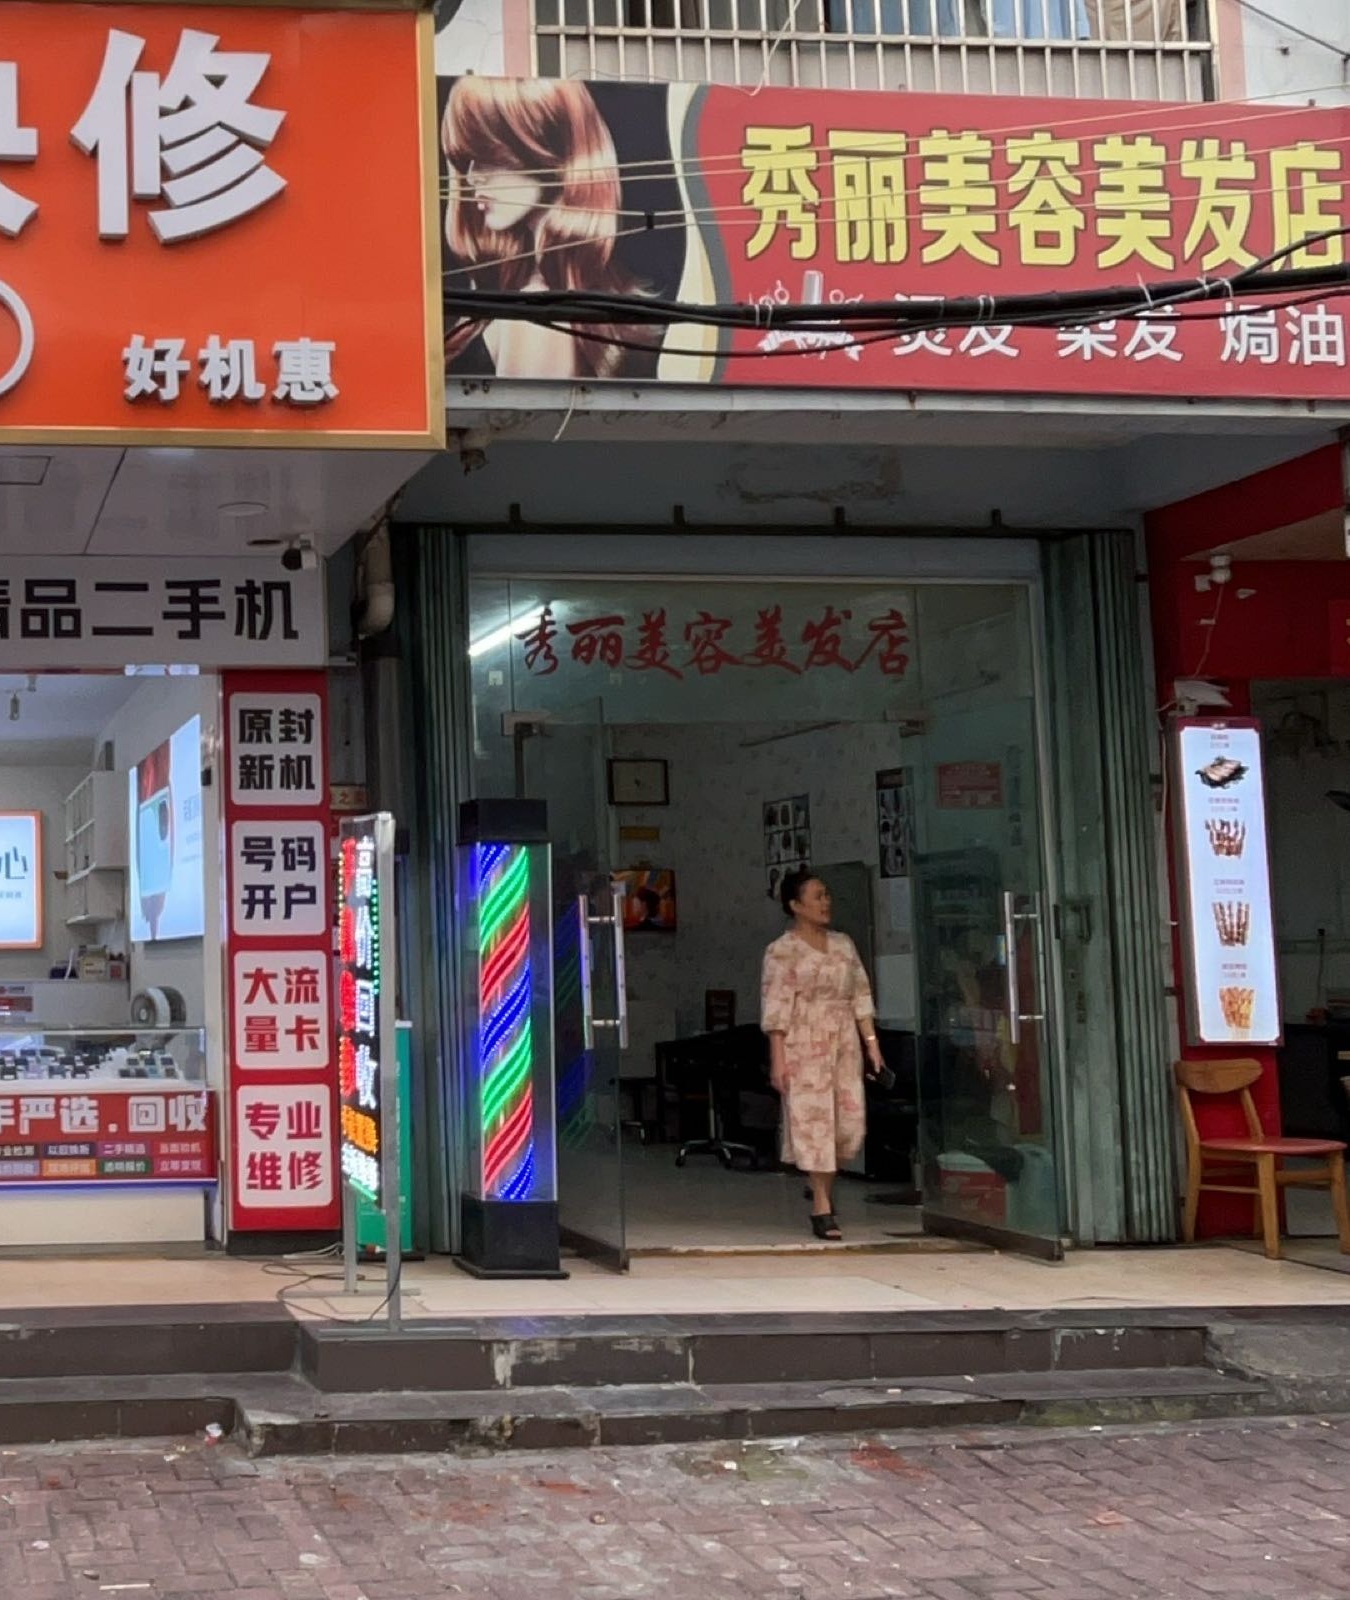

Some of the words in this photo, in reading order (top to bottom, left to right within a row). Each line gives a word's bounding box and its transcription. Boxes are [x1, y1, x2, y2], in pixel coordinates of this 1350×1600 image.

[741, 123, 1344, 274] 秀丽美容美发店
[1218, 301, 1347, 367] 焗油
[122, 334, 340, 404] 好机惠
[515, 603, 912, 680] 秀丽美容美发店
[238, 708, 315, 745] 原封
[238, 754, 315, 791] 新机
[240, 835, 317, 873] 号码
[241, 883, 318, 920] 开户
[242, 966, 320, 1006] 大流
[244, 1015, 321, 1054] 量卡
[245, 1102, 323, 1141] 专业
[246, 1150, 325, 1192] 维修
